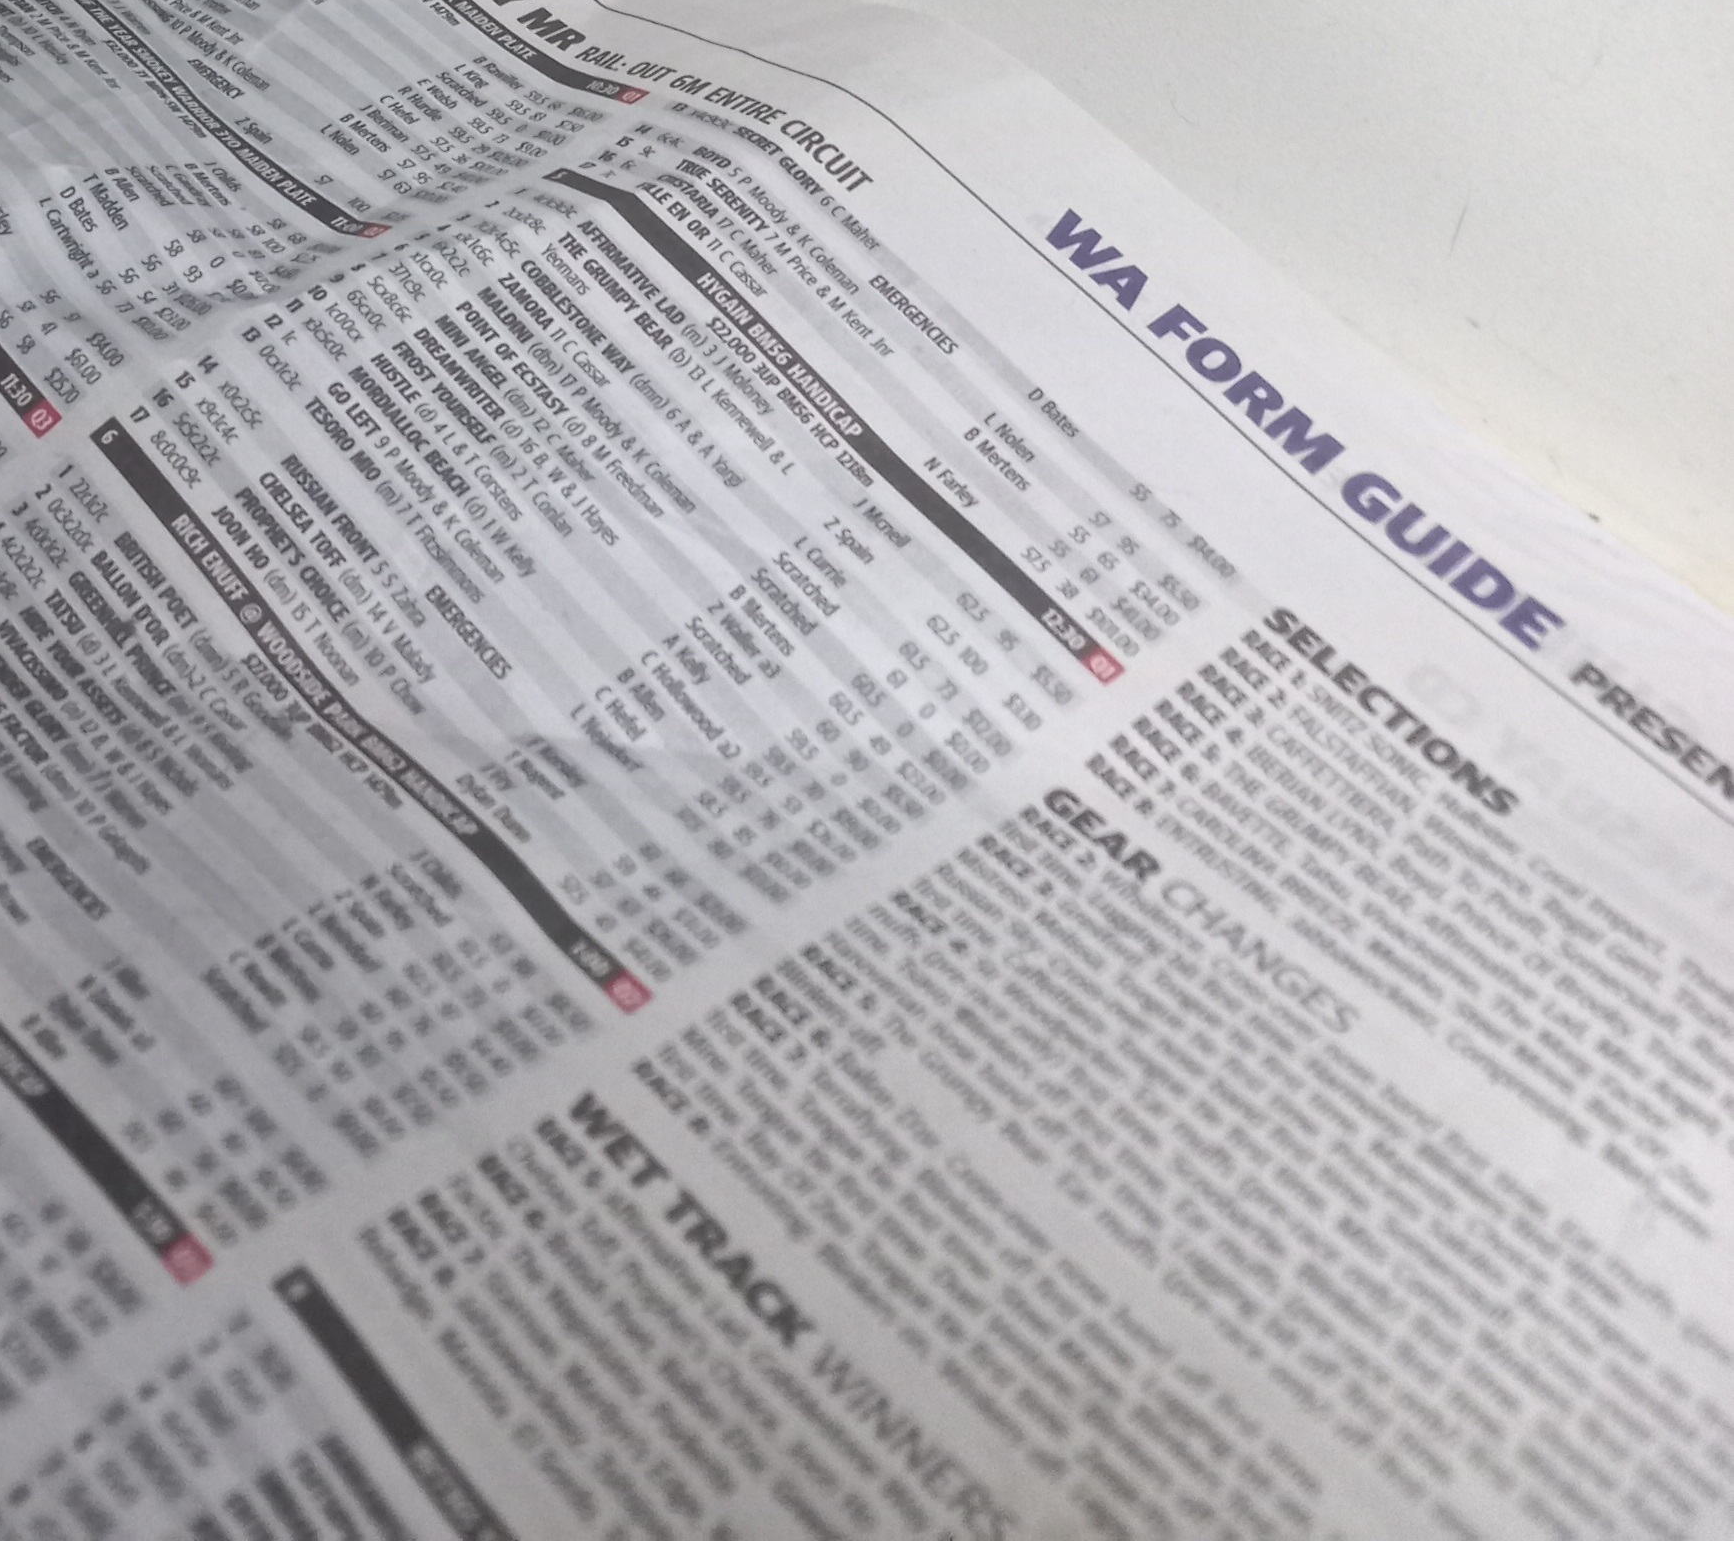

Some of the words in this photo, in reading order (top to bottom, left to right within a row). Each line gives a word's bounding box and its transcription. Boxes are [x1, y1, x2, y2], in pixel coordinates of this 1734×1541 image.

[458, 0, 502, 41] MAIDEN
[497, 33, 534, 61] PLATE
[187, 58, 246, 101] EMERGENCY
[517, 7, 587, 52] MR
[575, 45, 628, 72] RAIL:
[626, 60, 677, 83] OUT
[669, 74, 712, 97] 6M
[704, 85, 787, 126] ENTIRE
[780, 118, 875, 193] CIRCUIT
[171, 85, 219, 132] WARRIOR
[215, 125, 242, 151] 3YO
[237, 143, 279, 183] MAIDEN
[276, 174, 317, 208] PLATE
[327, 129, 361, 157] Nolen
[348, 120, 392, 154] Mertens
[69, 195, 98, 234] Bates
[692, 145, 733, 169] BOYD
[747, 184, 789, 226] Moody
[806, 241, 860, 296] Coleman
[733, 125, 784, 157] SECRET
[779, 156, 825, 197] GLORY
[840, 213, 882, 251] Maher
[45, 206, 95, 271] Cartwright
[539, 242, 591, 297] Yeomans
[577, 219, 661, 302] AFFIRMATIVE
[654, 296, 686, 325] LAD
[680, 320, 709, 349] (m)
[666, 201, 690, 223] EN
[686, 217, 712, 241] OR
[727, 260, 769, 298] Cassar
[674, 157, 709, 181] TRUE
[705, 173, 770, 234] SERENITY
[787, 251, 818, 286] Price
[842, 315, 874, 340] Kent
[870, 336, 895, 358] Jnr
[738, 237, 779, 276] Maher
[498, 272, 555, 332] ZAMORA
[572, 348, 611, 388] Cassar
[519, 258, 608, 348] COBBLESTONE
[600, 342, 638, 375] WAY
[629, 373, 667, 412] (dmn)
[557, 230, 588, 261] THE
[582, 258, 640, 314] GRUMPY
[634, 311, 675, 351] BEAR
[668, 347, 693, 370] (b)
[711, 388, 776, 453] Kennewell
[695, 271, 759, 327] HYGAIN
[746, 322, 794, 367] BM56
[786, 363, 866, 437] HANDICAP
[869, 275, 959, 356] EMERGENCIES
[0, 373, 34, 408] 11:30
[391, 340, 437, 384] FROST
[430, 381, 498, 446] YOURSELF
[413, 326, 506, 421] DREAMWRITER
[434, 314, 470, 349] MINI
[464, 347, 509, 391] ANGEL
[503, 388, 537, 419] (dm)
[557, 444, 597, 483] Maher
[455, 300, 501, 345] POINT
[494, 342, 520, 363] OF
[511, 361, 571, 418] ECSTASY
[561, 415, 586, 438] (d)
[606, 459, 666, 519] Freedman
[476, 286, 534, 345] MALDINI
[582, 395, 625, 442] Moody
[644, 461, 698, 515] Coleman
[750, 359, 782, 387] 3UP
[775, 386, 816, 425] BM56
[809, 421, 840, 450] HCP
[1041, 400, 1082, 439] Bates
[305, 395, 357, 453] TESORO
[349, 448, 381, 482] MIO
[347, 366, 431, 453] MORDIALLOC
[423, 448, 472, 499] BEACH
[369, 352, 422, 405] HUSTLE
[413, 402, 439, 424] (d)
[473, 464, 523, 523] Corstens
[975, 440, 1032, 493] Mertens
[994, 421, 1037, 465] Nolen
[1044, 207, 1149, 312] WA
[1147, 303, 1346, 476] FORM
[1340, 471, 1568, 652] GUIDE
[258, 471, 315, 534] CHELSEA
[309, 529, 347, 568] TOFF
[280, 452, 339, 518] RUSSIAN
[331, 513, 380, 563] FRONT
[327, 381, 352, 405] GO
[345, 399, 383, 439] LEFT
[394, 458, 436, 504] Moody
[454, 528, 505, 584] Coleman
[936, 467, 981, 510] Farley
[114, 530, 167, 591] BRITISH
[158, 585, 198, 630] POET
[211, 505, 252, 548] JOON
[244, 543, 272, 570] HO
[235, 486, 306, 567] PROPHET'S
[299, 565, 351, 624] CHOICE
[835, 526, 876, 565] Spain
[170, 513, 210, 556] RICH
[200, 549, 250, 601] ENUFF
[255, 619, 332, 705] WOODSIDE
[424, 583, 513, 680] EMERGENCIES
[1239, 627, 1293, 675] RACE
[1174, 678, 1227, 727] RACE
[1197, 661, 1248, 710] RACE
[1217, 644, 1270, 693] RACE
[1263, 605, 1522, 819] SELECTIONS
[1131, 714, 1183, 765] RACE
[1153, 698, 1203, 747] RACE
[1041, 786, 1163, 885] GEAR
[1159, 875, 1362, 1036] CHANGES
[569, 1090, 669, 1189] WET
[666, 1186, 818, 1350] TRACK
